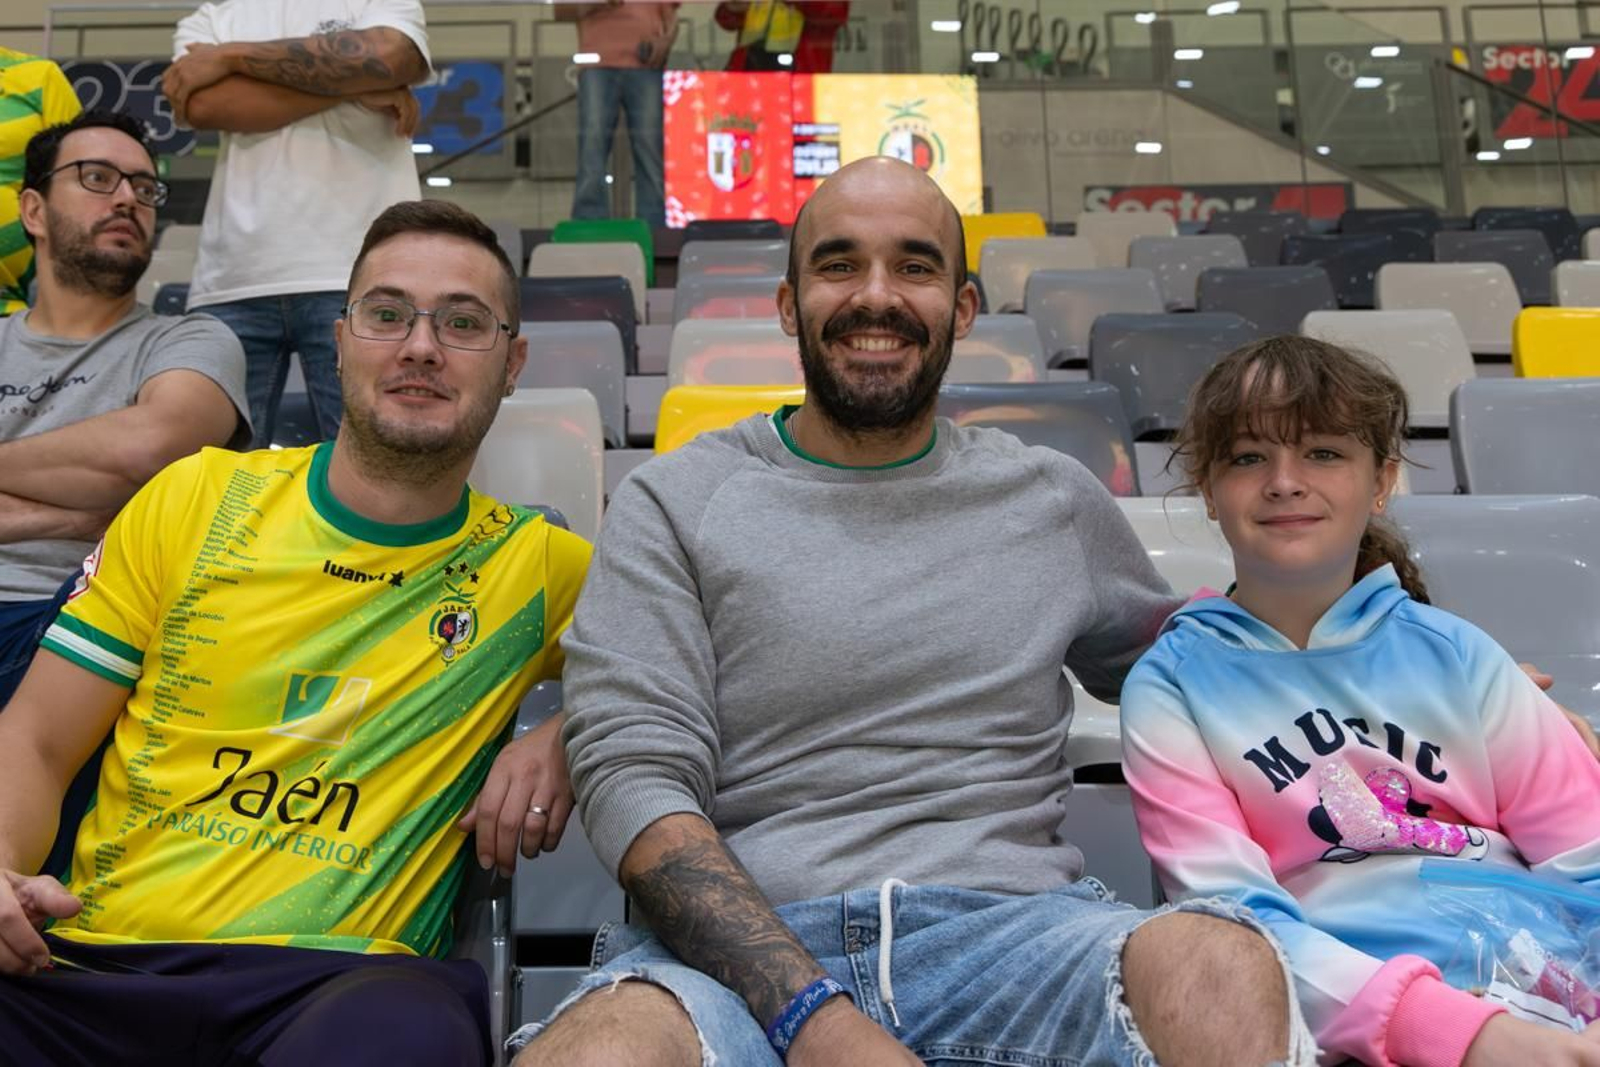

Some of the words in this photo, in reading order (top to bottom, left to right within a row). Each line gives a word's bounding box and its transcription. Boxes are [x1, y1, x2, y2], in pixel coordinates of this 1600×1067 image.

[184, 746, 360, 832] Jaén
[147, 811, 249, 846] PARAÍSO
[250, 829, 373, 870] INTERIOR
